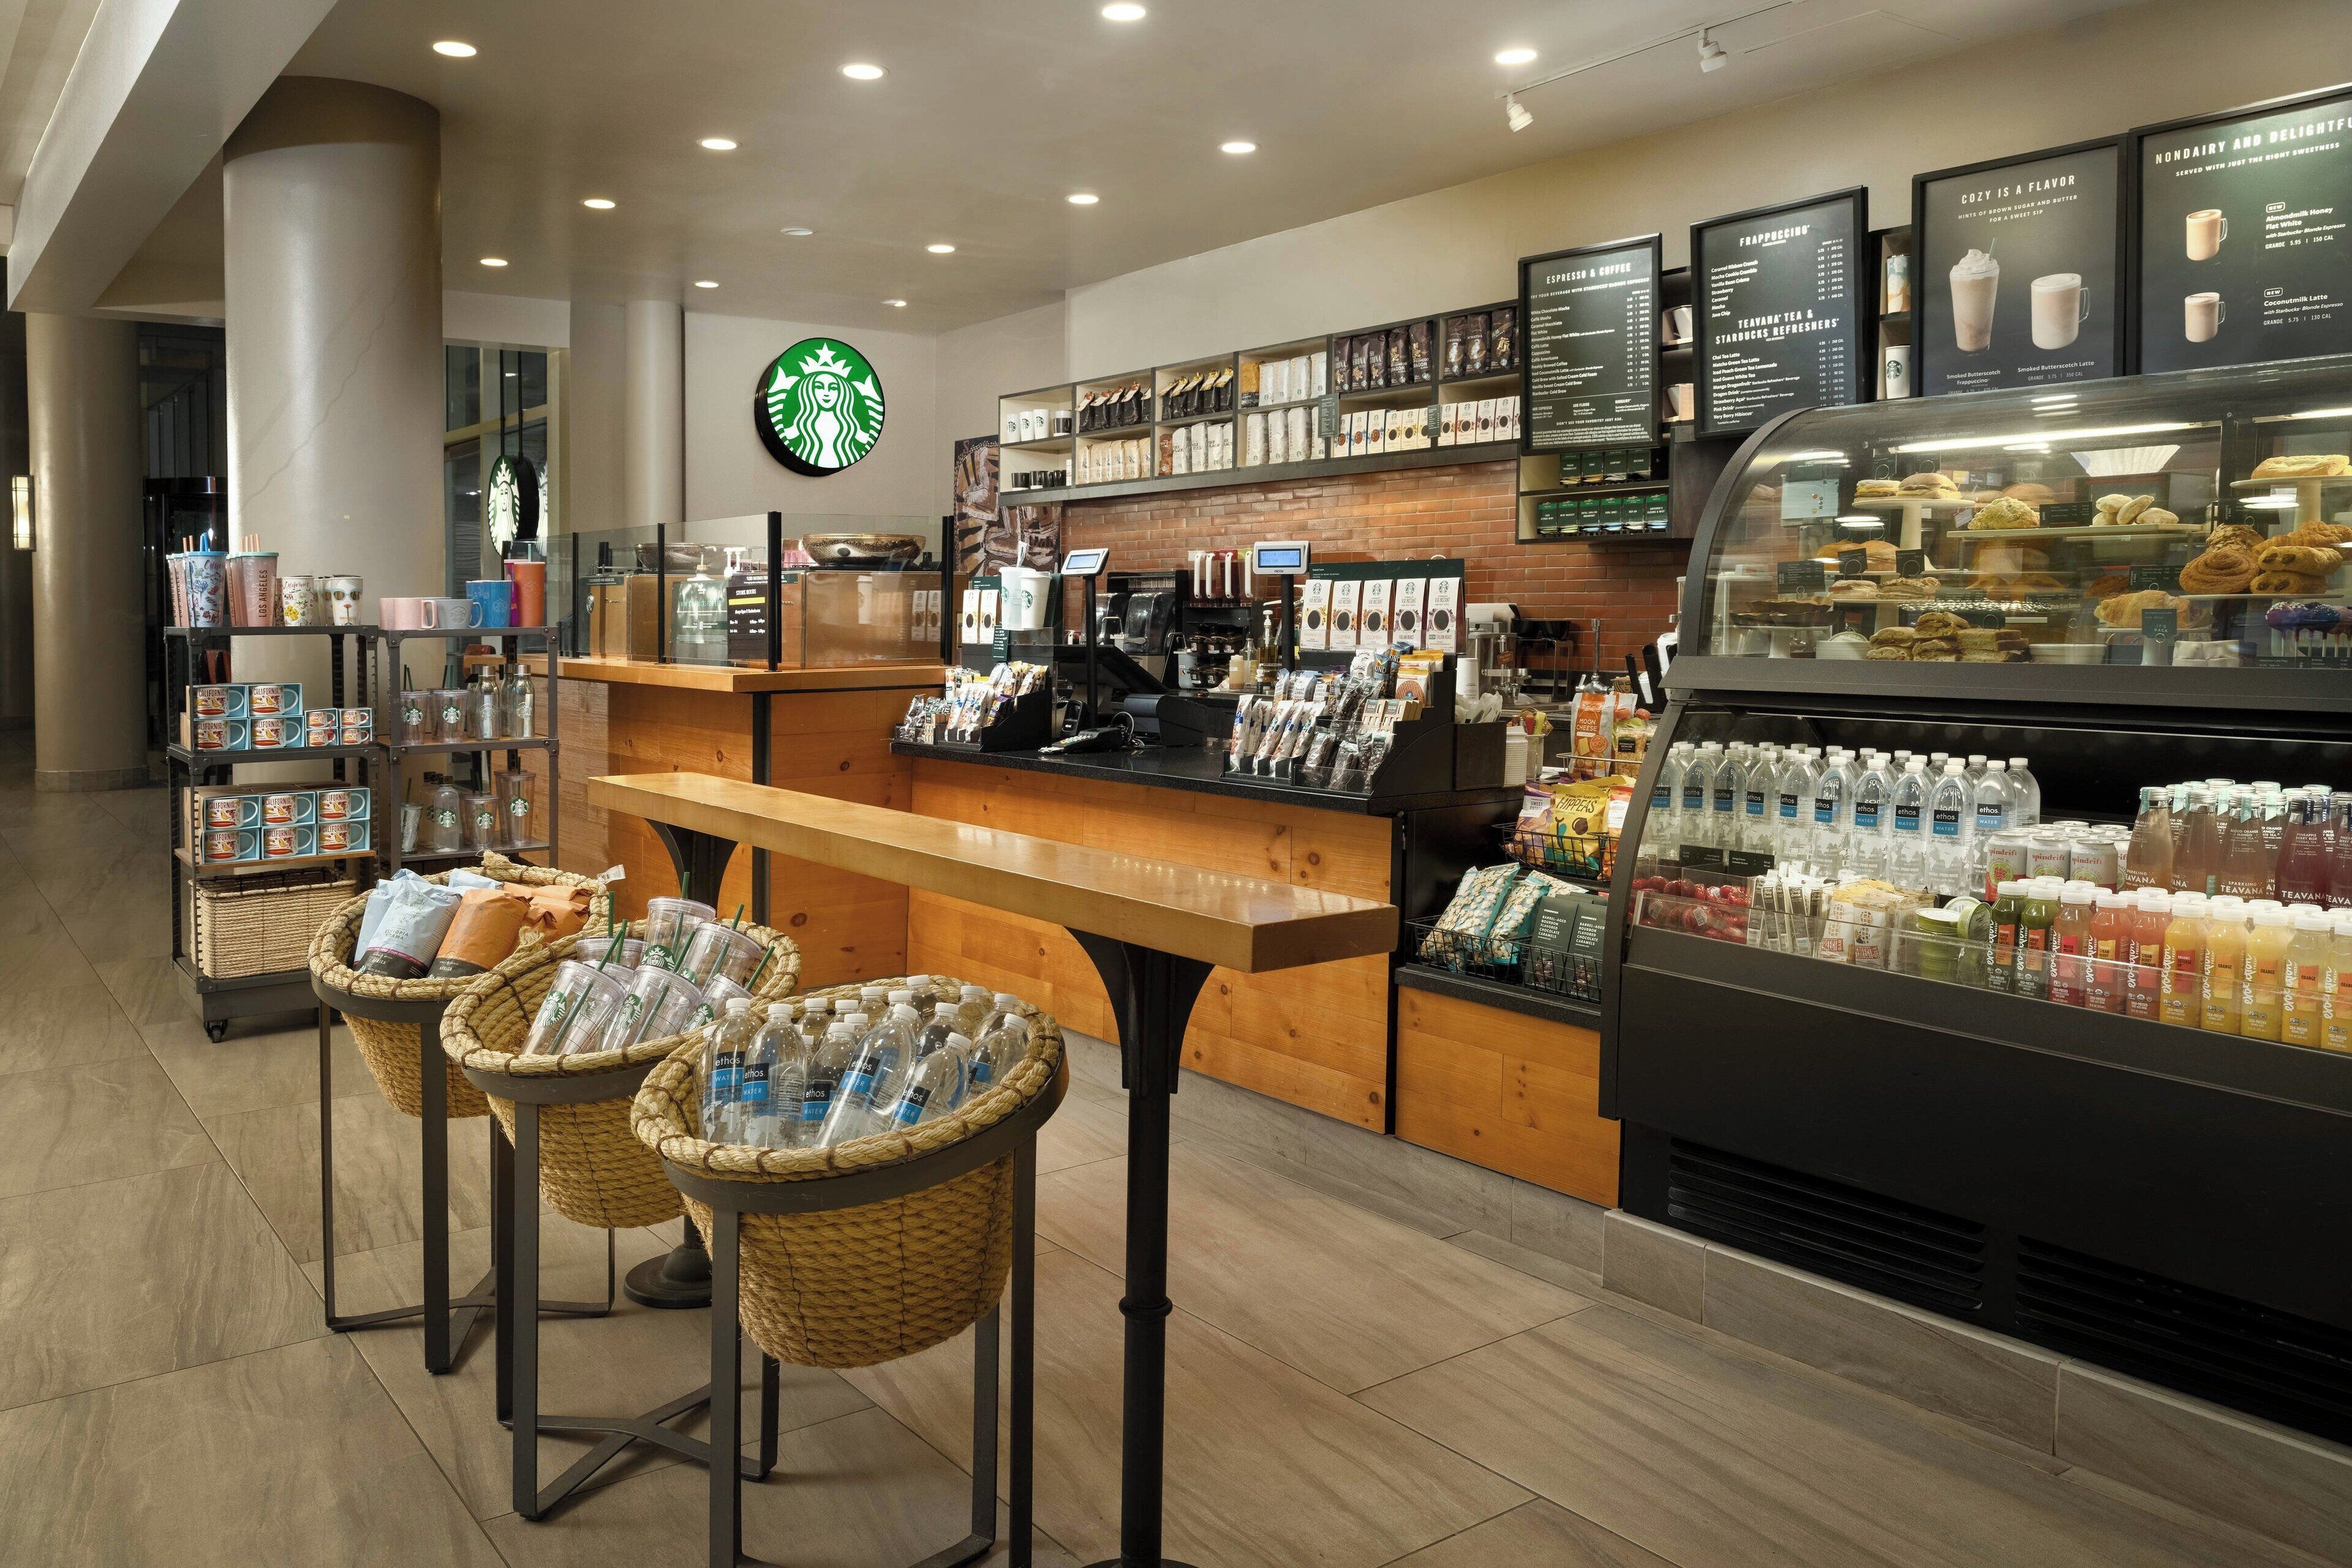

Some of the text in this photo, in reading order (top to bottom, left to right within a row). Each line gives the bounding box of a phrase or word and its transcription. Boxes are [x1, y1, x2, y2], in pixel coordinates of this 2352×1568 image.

[2155, 141, 2225, 165] NONDAIRY
[2233, 134, 2261, 151] AND
[2176, 142, 2340, 177] SERVED WITH JUST THE RIGHT SWEETNESS
[1962, 175, 2076, 205] COZY IS A FLAVOR
[2014, 202, 2035, 211] SUGAR
[2052, 195, 2078, 203] BUTTER
[2266, 210, 2309, 222] Almondmilk
[1547, 262, 1631, 284] ESPRESSO & COFFEE
[2264, 296, 2309, 307] Coconutmilk
[1784, 311, 1801, 323] TEA
[1807, 309, 1814, 319] &
[1716, 328, 1769, 344] STARBUCKS
[2041, 362, 2078, 371] Butterscotch
[1967, 369, 2001, 379] Butterscotch
[258, 569, 268, 617] LOS ANGELES
[198, 688, 225, 697] CALIFORNIA
[254, 687, 279, 696] CALIFORNIA
[254, 720, 280, 729] CALIFORNIA
[209, 802, 235, 810] CALIFORNIA
[1556, 798, 1597, 813] HIPPEAS
[2071, 857, 2103, 865] spindrift
[2220, 884, 2263, 894] TEAVANA
[2282, 890, 2326, 901] TEAVANA
[1542, 915, 1567, 924] BARREL-AGED
[715, 1074, 740, 1083] WATER
